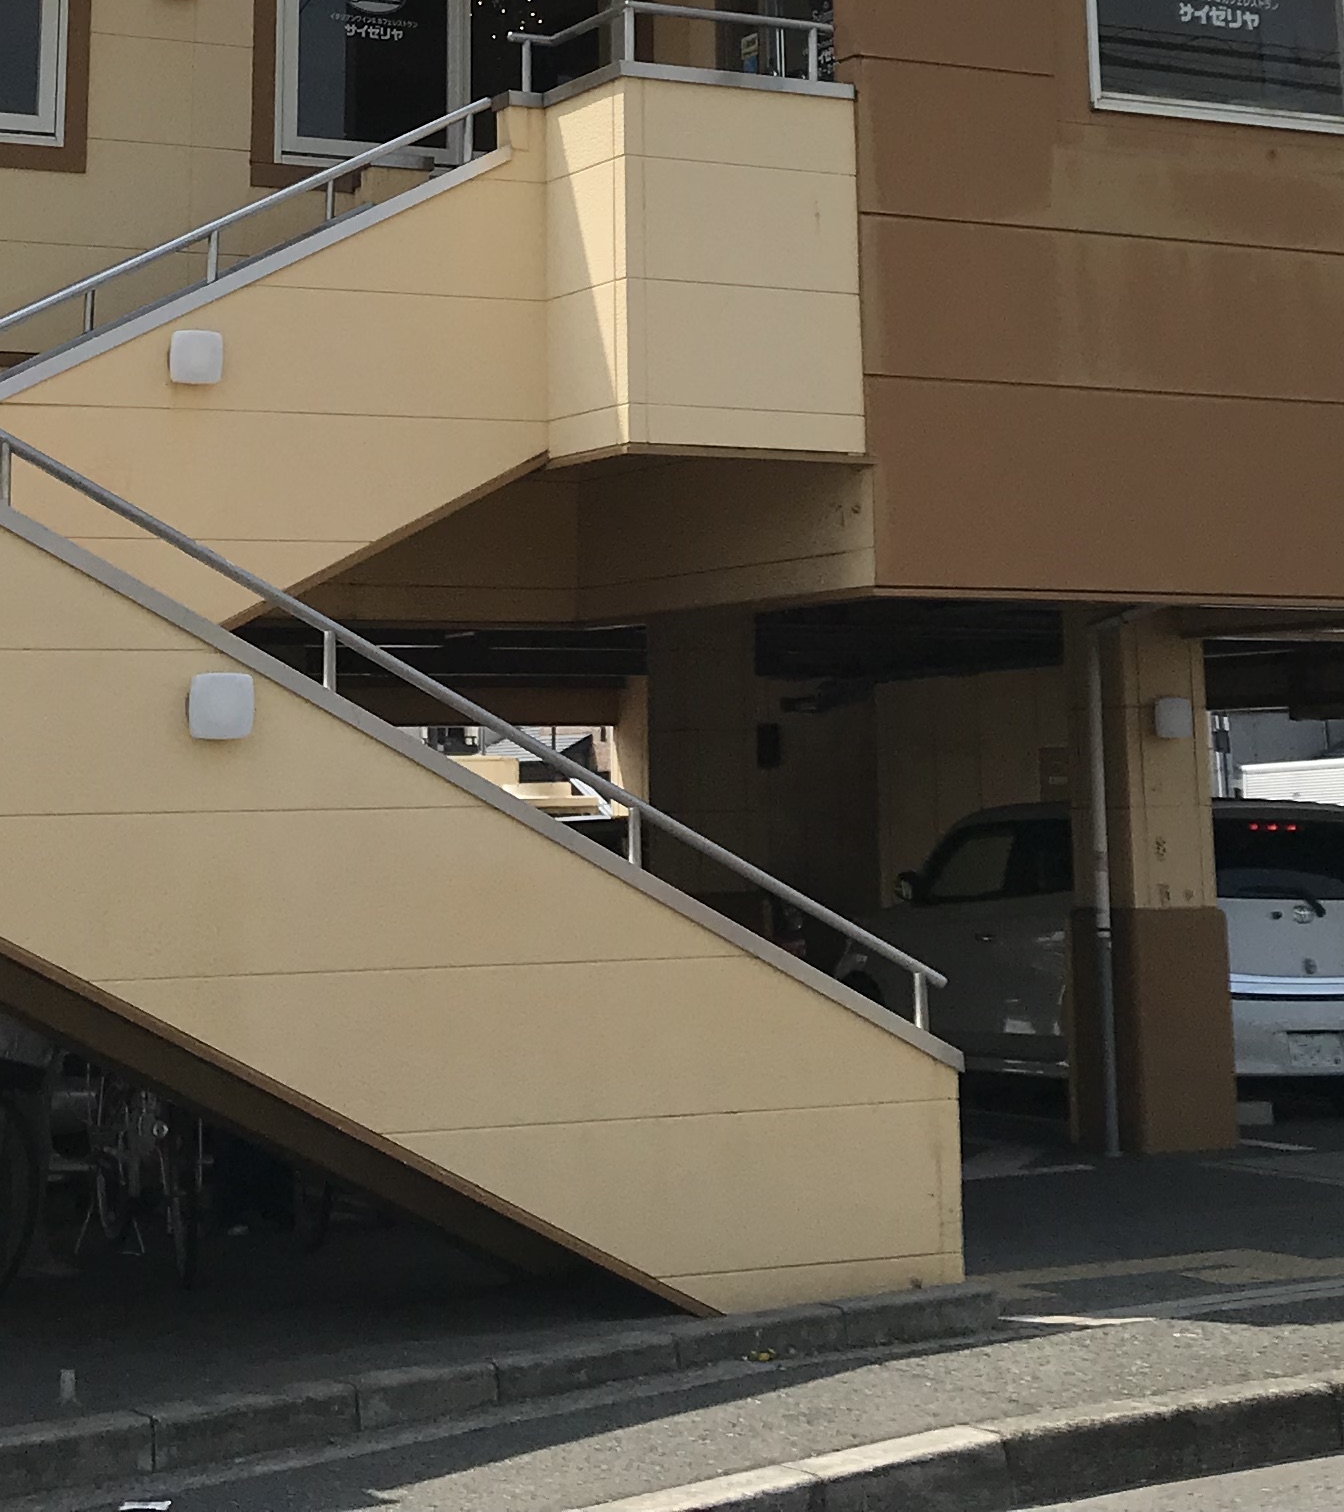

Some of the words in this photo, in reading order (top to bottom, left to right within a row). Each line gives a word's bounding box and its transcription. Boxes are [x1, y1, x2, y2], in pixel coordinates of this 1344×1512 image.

[1178, 2, 1260, 30] サイゼリヤ
[344, 23, 404, 41] サイゼリヤ
